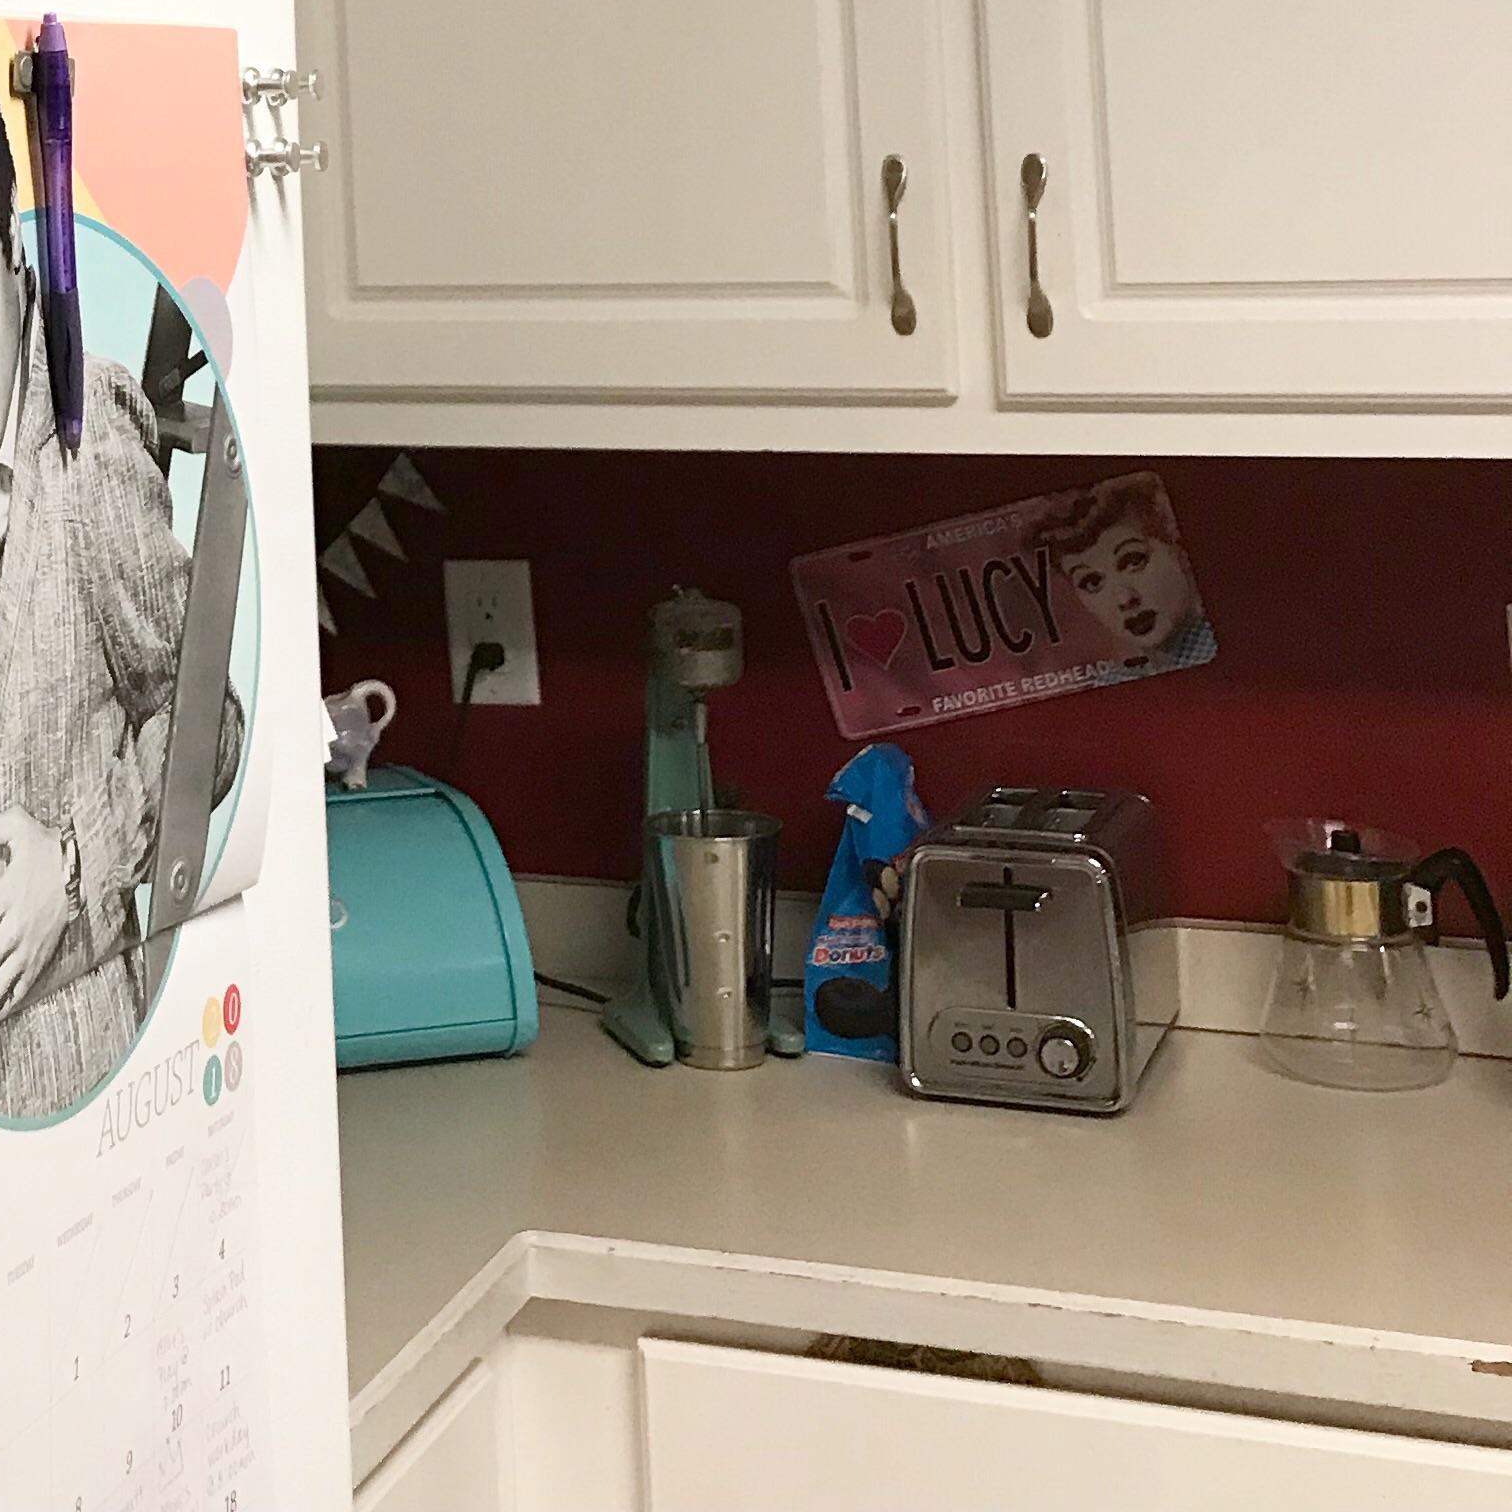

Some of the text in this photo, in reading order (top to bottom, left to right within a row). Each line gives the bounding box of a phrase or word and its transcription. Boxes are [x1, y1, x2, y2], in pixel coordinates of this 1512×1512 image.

[817, 544, 1061, 693] I LUCY
[931, 681, 1019, 714] FAVORITE
[812, 943, 887, 966] Donuts
[96, 1039, 200, 1159] AUGUST
[171, 1403, 183, 1433] 10
